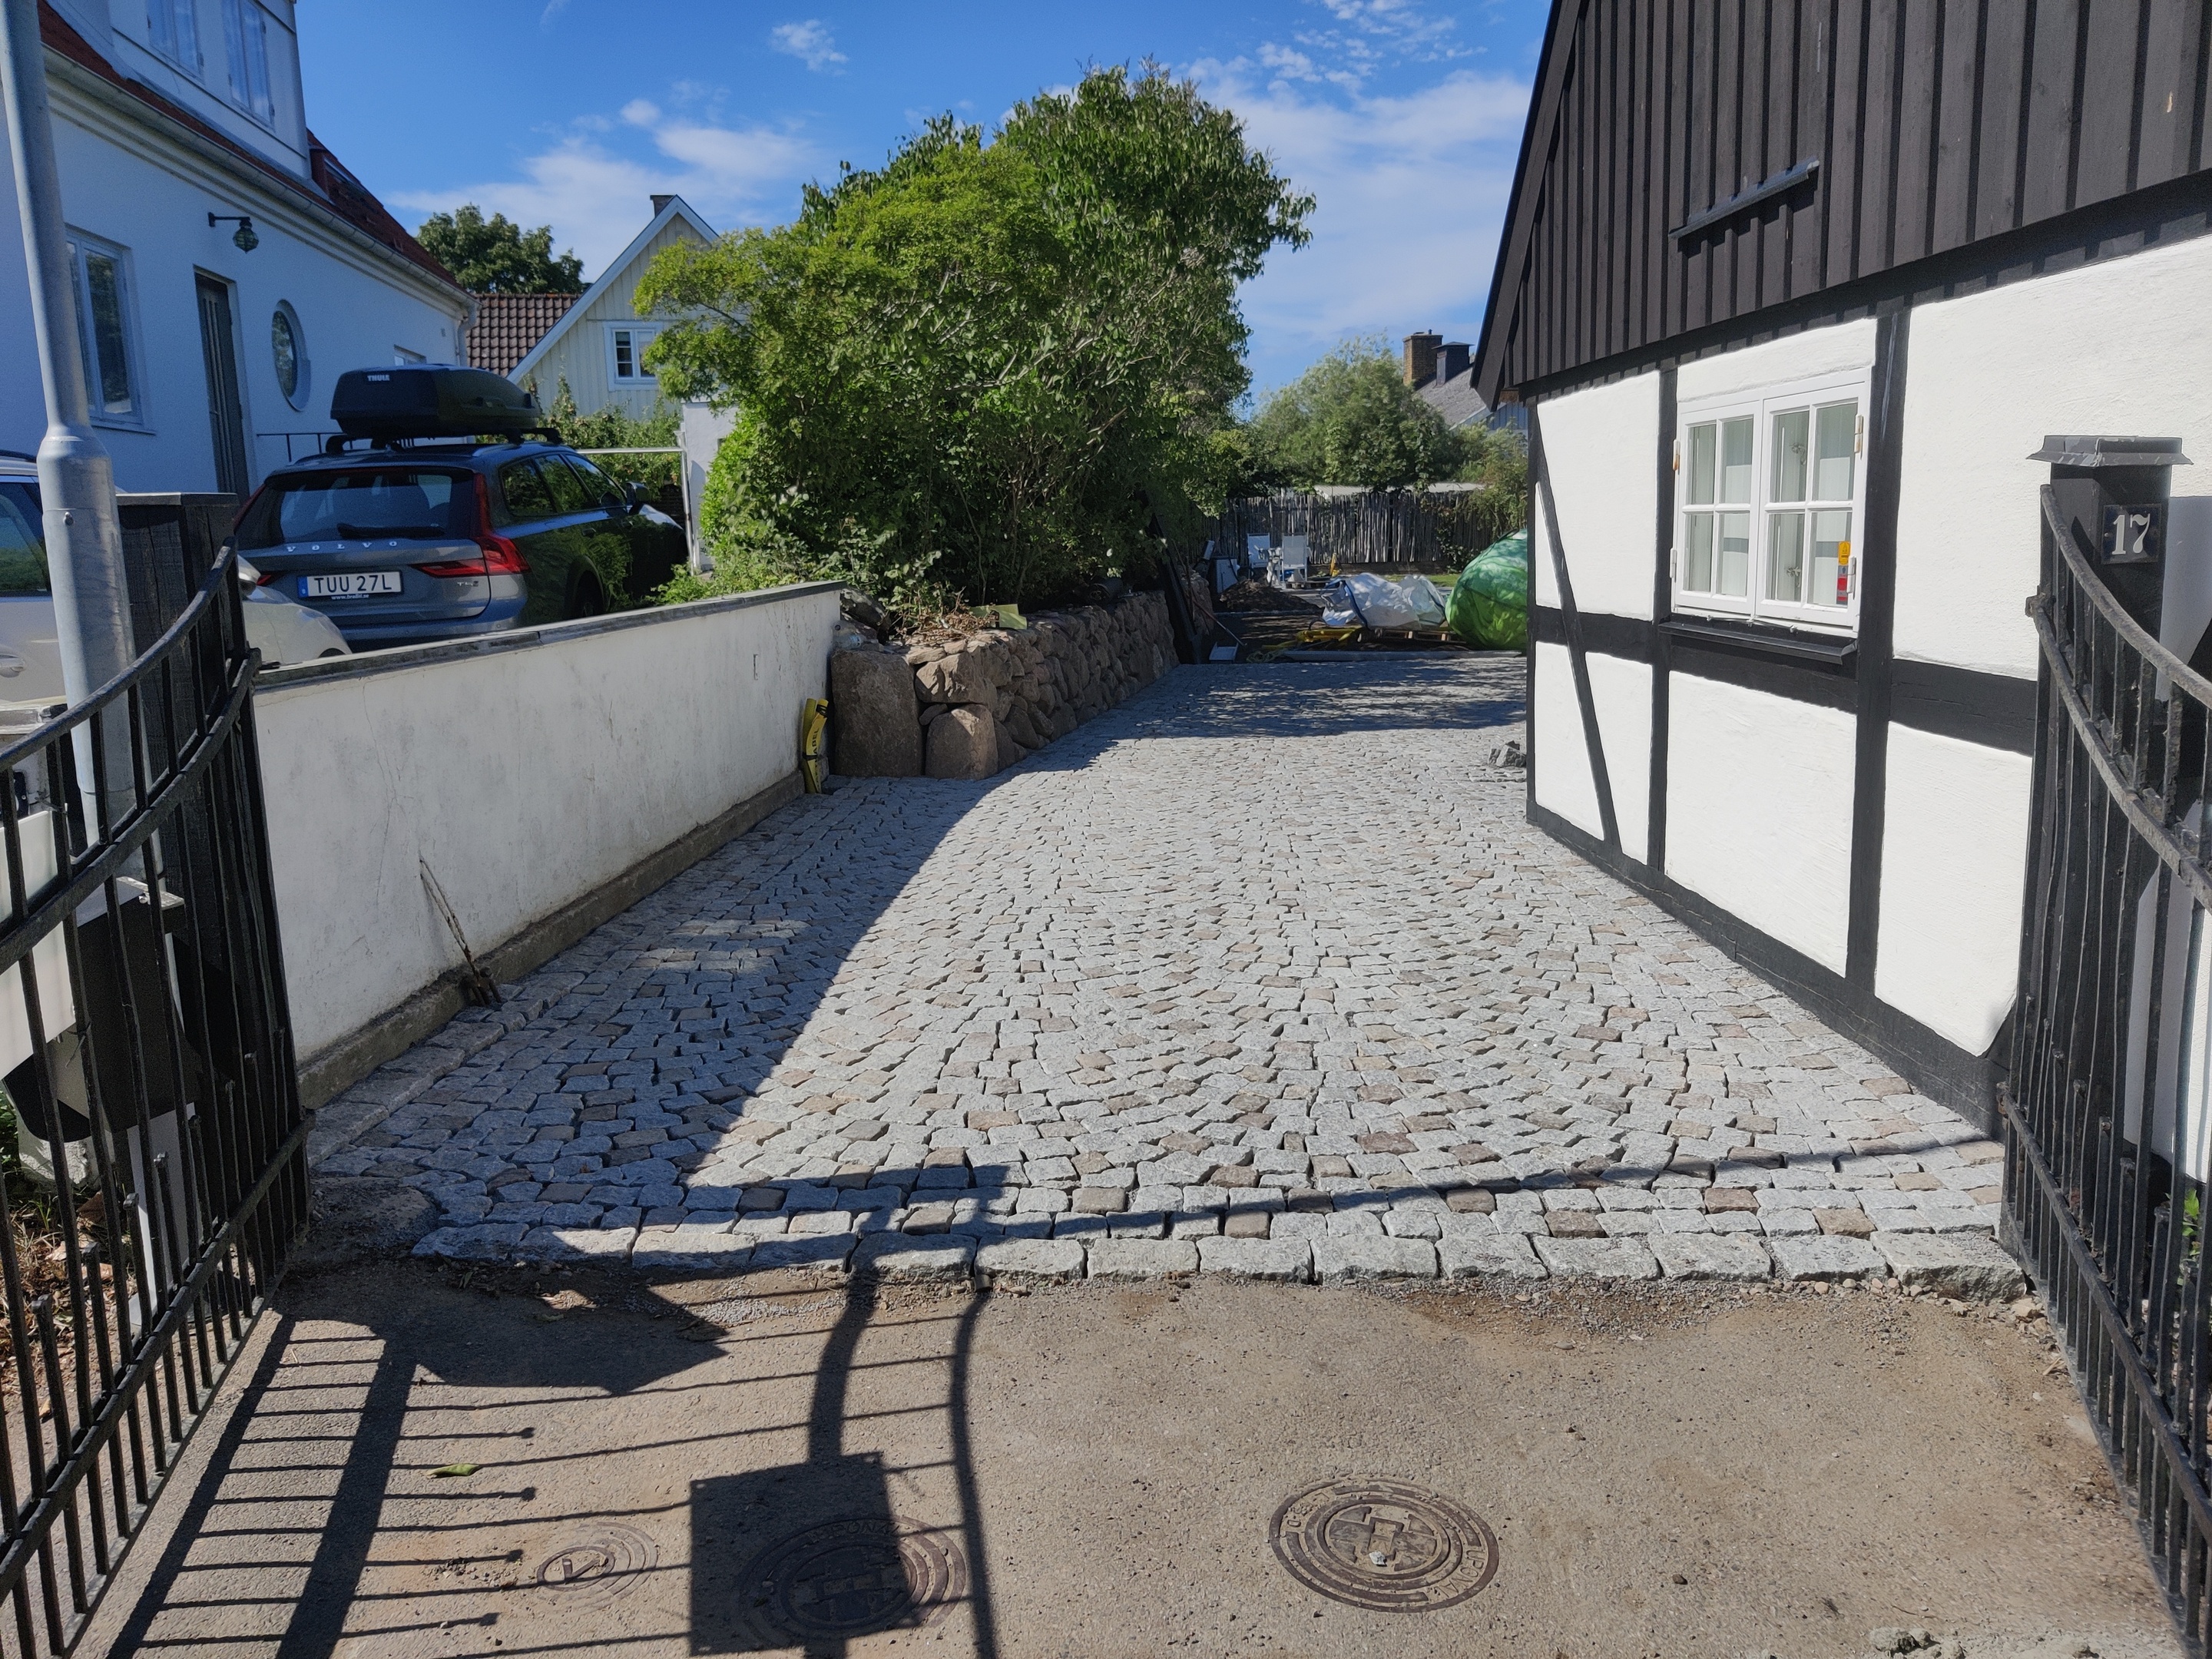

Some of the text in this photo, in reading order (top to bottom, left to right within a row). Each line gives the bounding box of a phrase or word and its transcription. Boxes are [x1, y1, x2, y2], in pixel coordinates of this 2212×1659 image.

[2111, 513, 2151, 555] 17
[286, 541, 397, 552] VOLVO
[313, 574, 392, 594] TUU 27L
